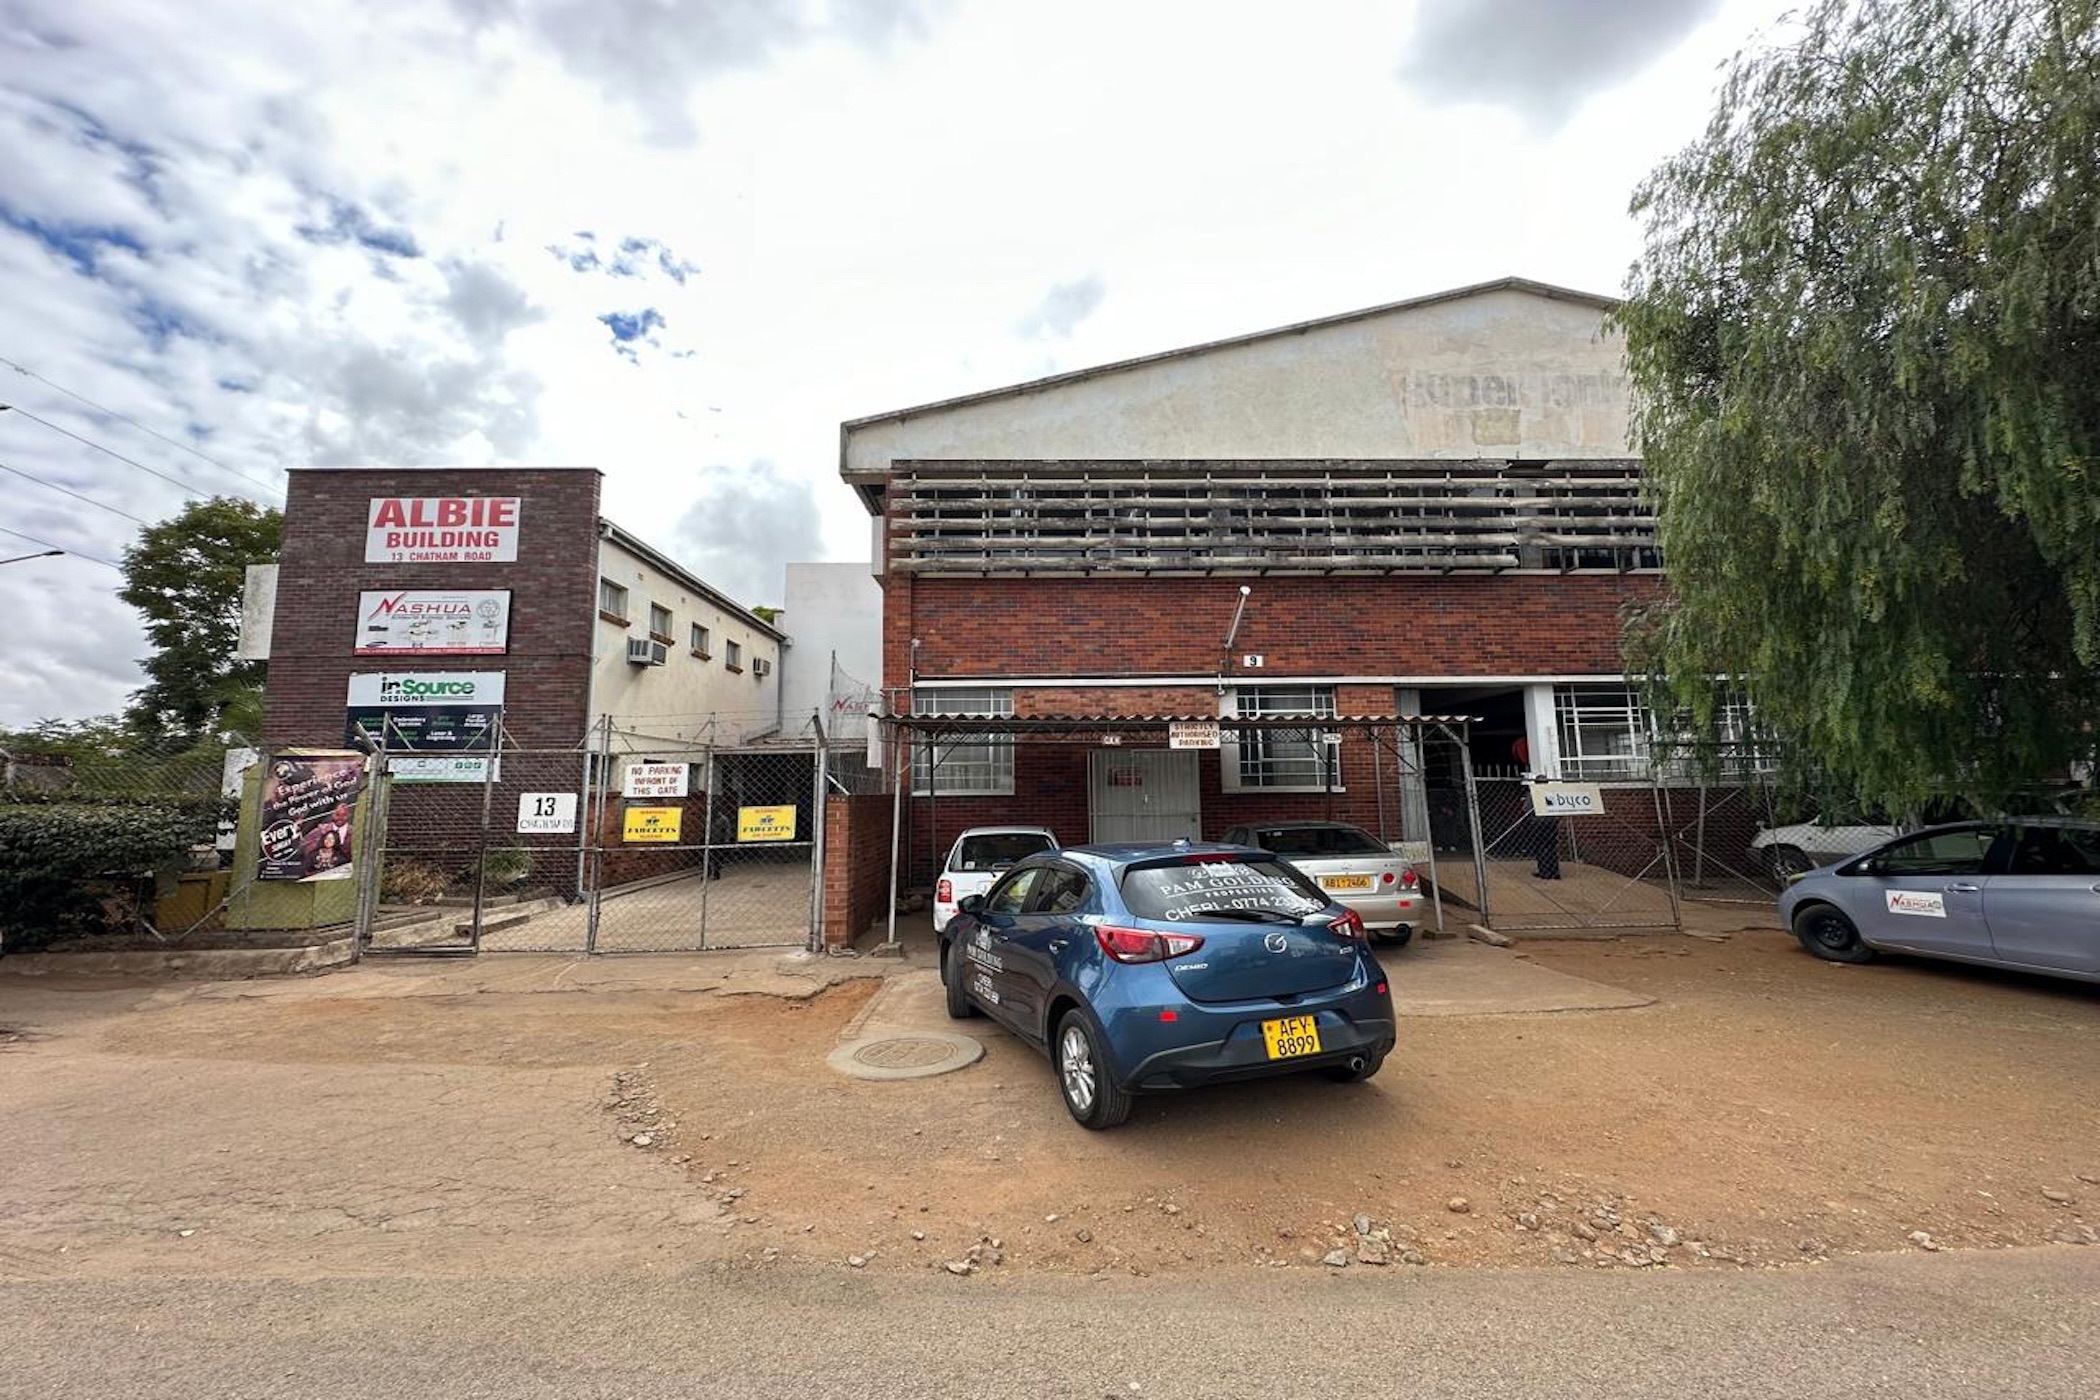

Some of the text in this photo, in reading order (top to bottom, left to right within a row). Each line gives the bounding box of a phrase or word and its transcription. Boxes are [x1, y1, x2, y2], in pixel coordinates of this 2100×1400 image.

[373, 499, 515, 528] ALBIE
[386, 531, 499, 549] BUILDING
[391, 551, 491, 561] 13 CHATHAM ROAD
[368, 592, 472, 621] NASHUA
[1249, 656, 1258, 666] 9
[380, 695, 425, 703] DESIGNS
[1174, 722, 1213, 731] STRICTLY
[631, 766, 683, 775] NO PARKING
[288, 789, 320, 804] Power
[334, 777, 357, 789] God
[632, 785, 678, 795] THIS GATE
[288, 803, 309, 817] God
[309, 796, 335, 809] with
[533, 797, 556, 816] 13
[261, 823, 303, 844] Every
[1159, 875, 1297, 896] PAM GOLDING
[1205, 887, 1274, 898] PROPERTIES
[1280, 1018, 1309, 1037] AFY
[1277, 1035, 1315, 1056] 8899
